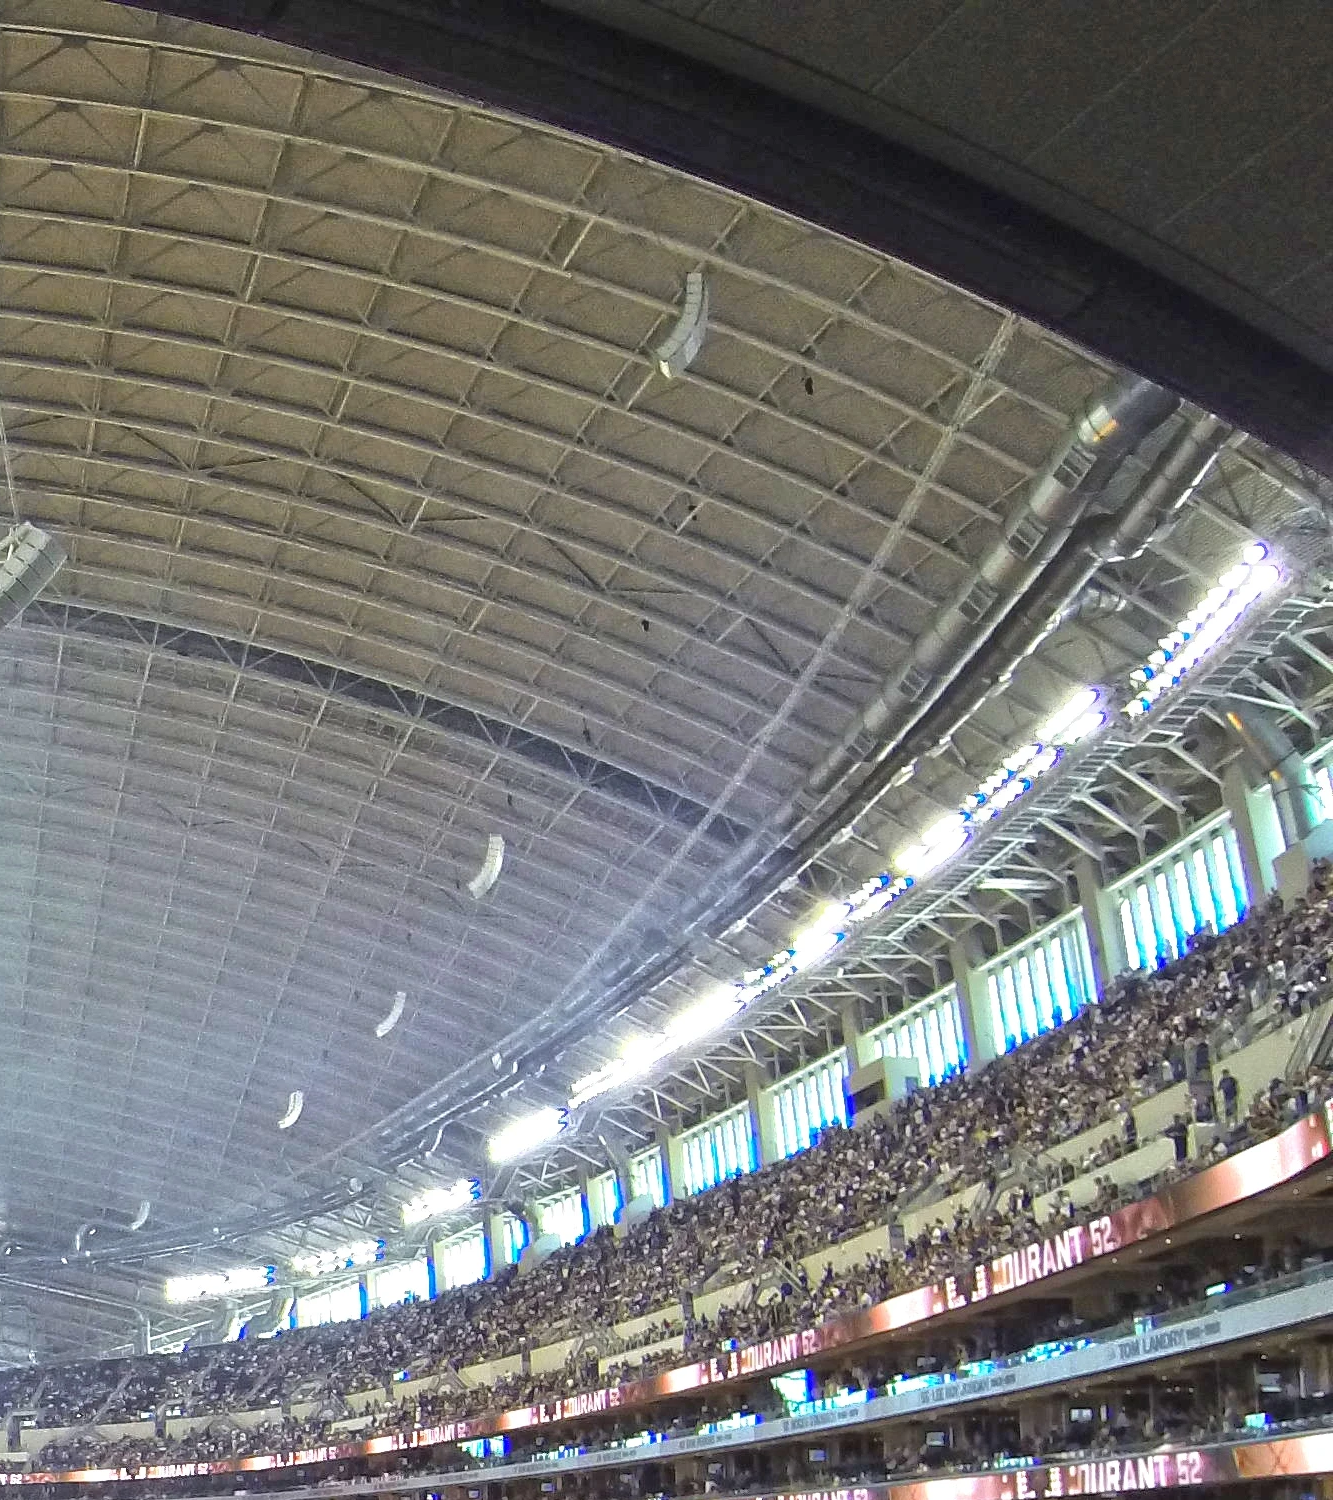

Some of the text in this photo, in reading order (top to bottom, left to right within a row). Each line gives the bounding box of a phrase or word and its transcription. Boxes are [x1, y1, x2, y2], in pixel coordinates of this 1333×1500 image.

[1005, 1216, 1115, 1290] DURANT 52
[749, 1334, 800, 1372] DURANT
[1143, 1328, 1185, 1353] LANDRY
[571, 1391, 609, 1418] DURANT
[425, 1424, 455, 1446] DURANT
[1081, 1451, 1203, 1492] DURANT 52
